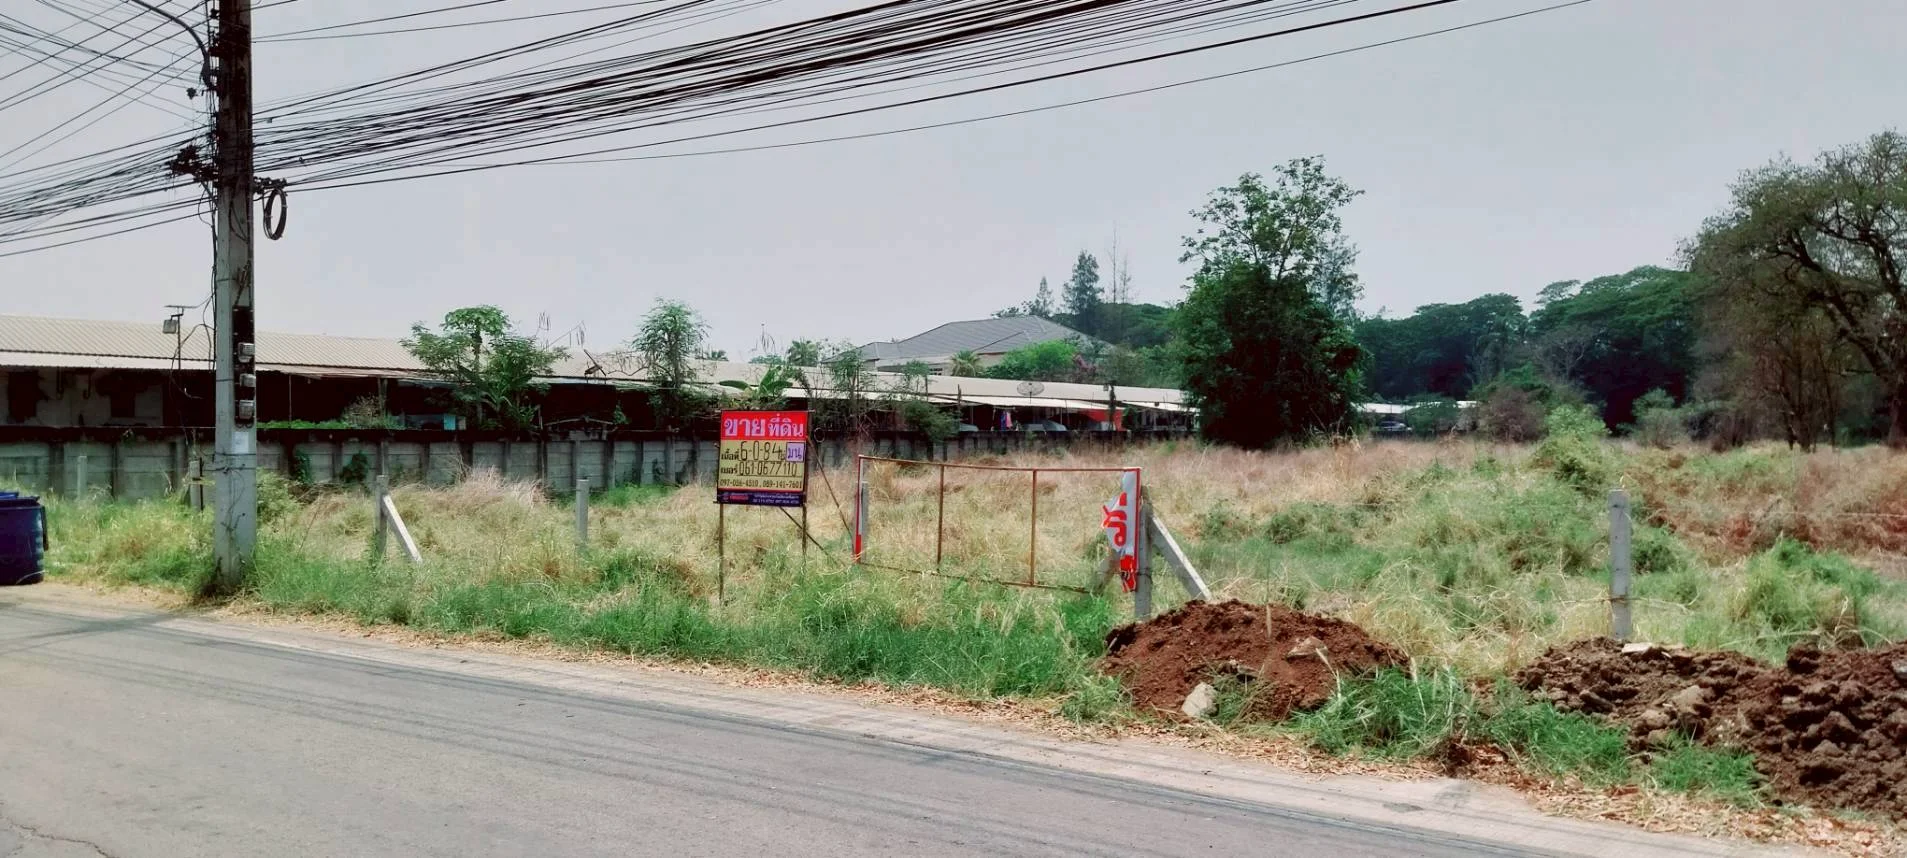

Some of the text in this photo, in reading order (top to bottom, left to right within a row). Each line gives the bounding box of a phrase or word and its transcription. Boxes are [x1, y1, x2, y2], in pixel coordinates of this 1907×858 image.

[724, 413, 804, 437] ขาย ที่ดิน
